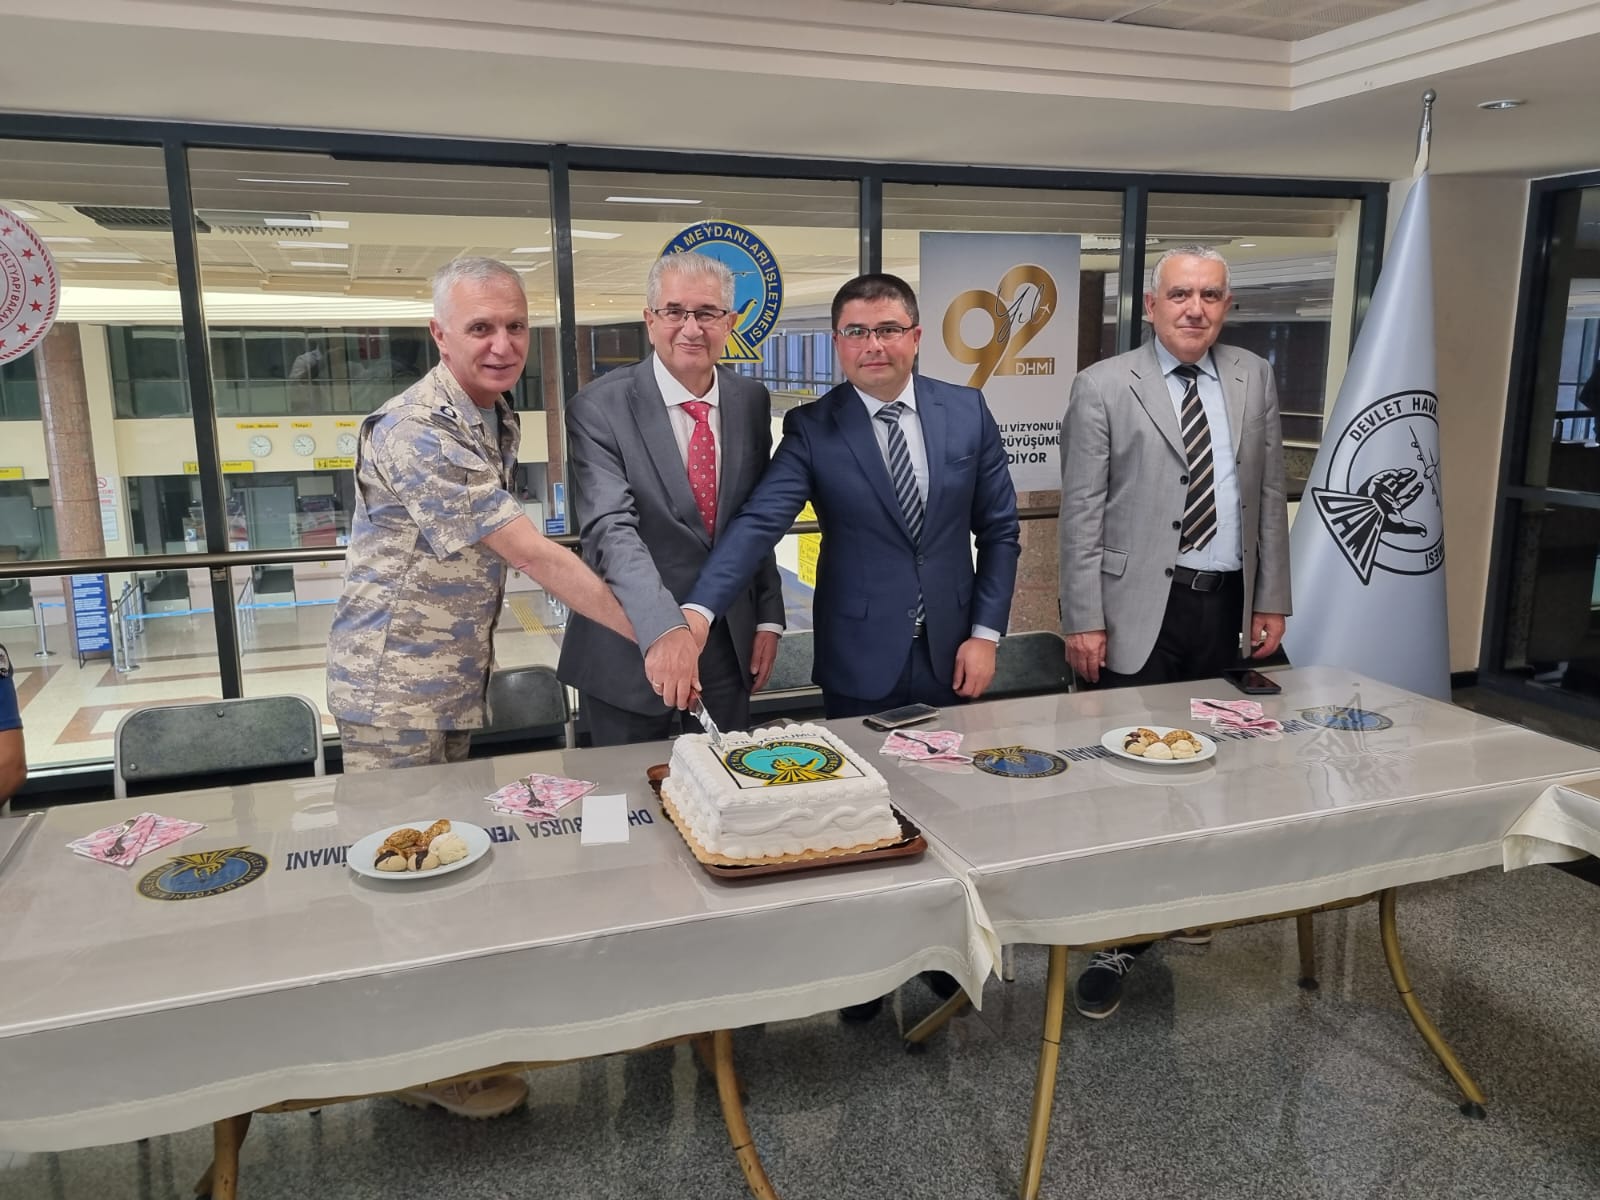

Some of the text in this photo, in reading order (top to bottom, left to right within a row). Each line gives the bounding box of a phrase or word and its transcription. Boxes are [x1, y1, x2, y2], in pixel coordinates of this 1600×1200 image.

[683, 225, 770, 266] MEYDANLARI
[1, 251, 21, 294] ALTYAPI
[942, 264, 1058, 389] 92
[1015, 359, 1053, 375] DHMİ
[1010, 421, 1054, 432] VİZYONU
[1349, 400, 1402, 442] DEVLET
[1000, 433, 1060, 449] RÜYÜŞÜMÜ
[1007, 450, 1047, 464] DİYOR
[285, 844, 352, 871] İMANI
